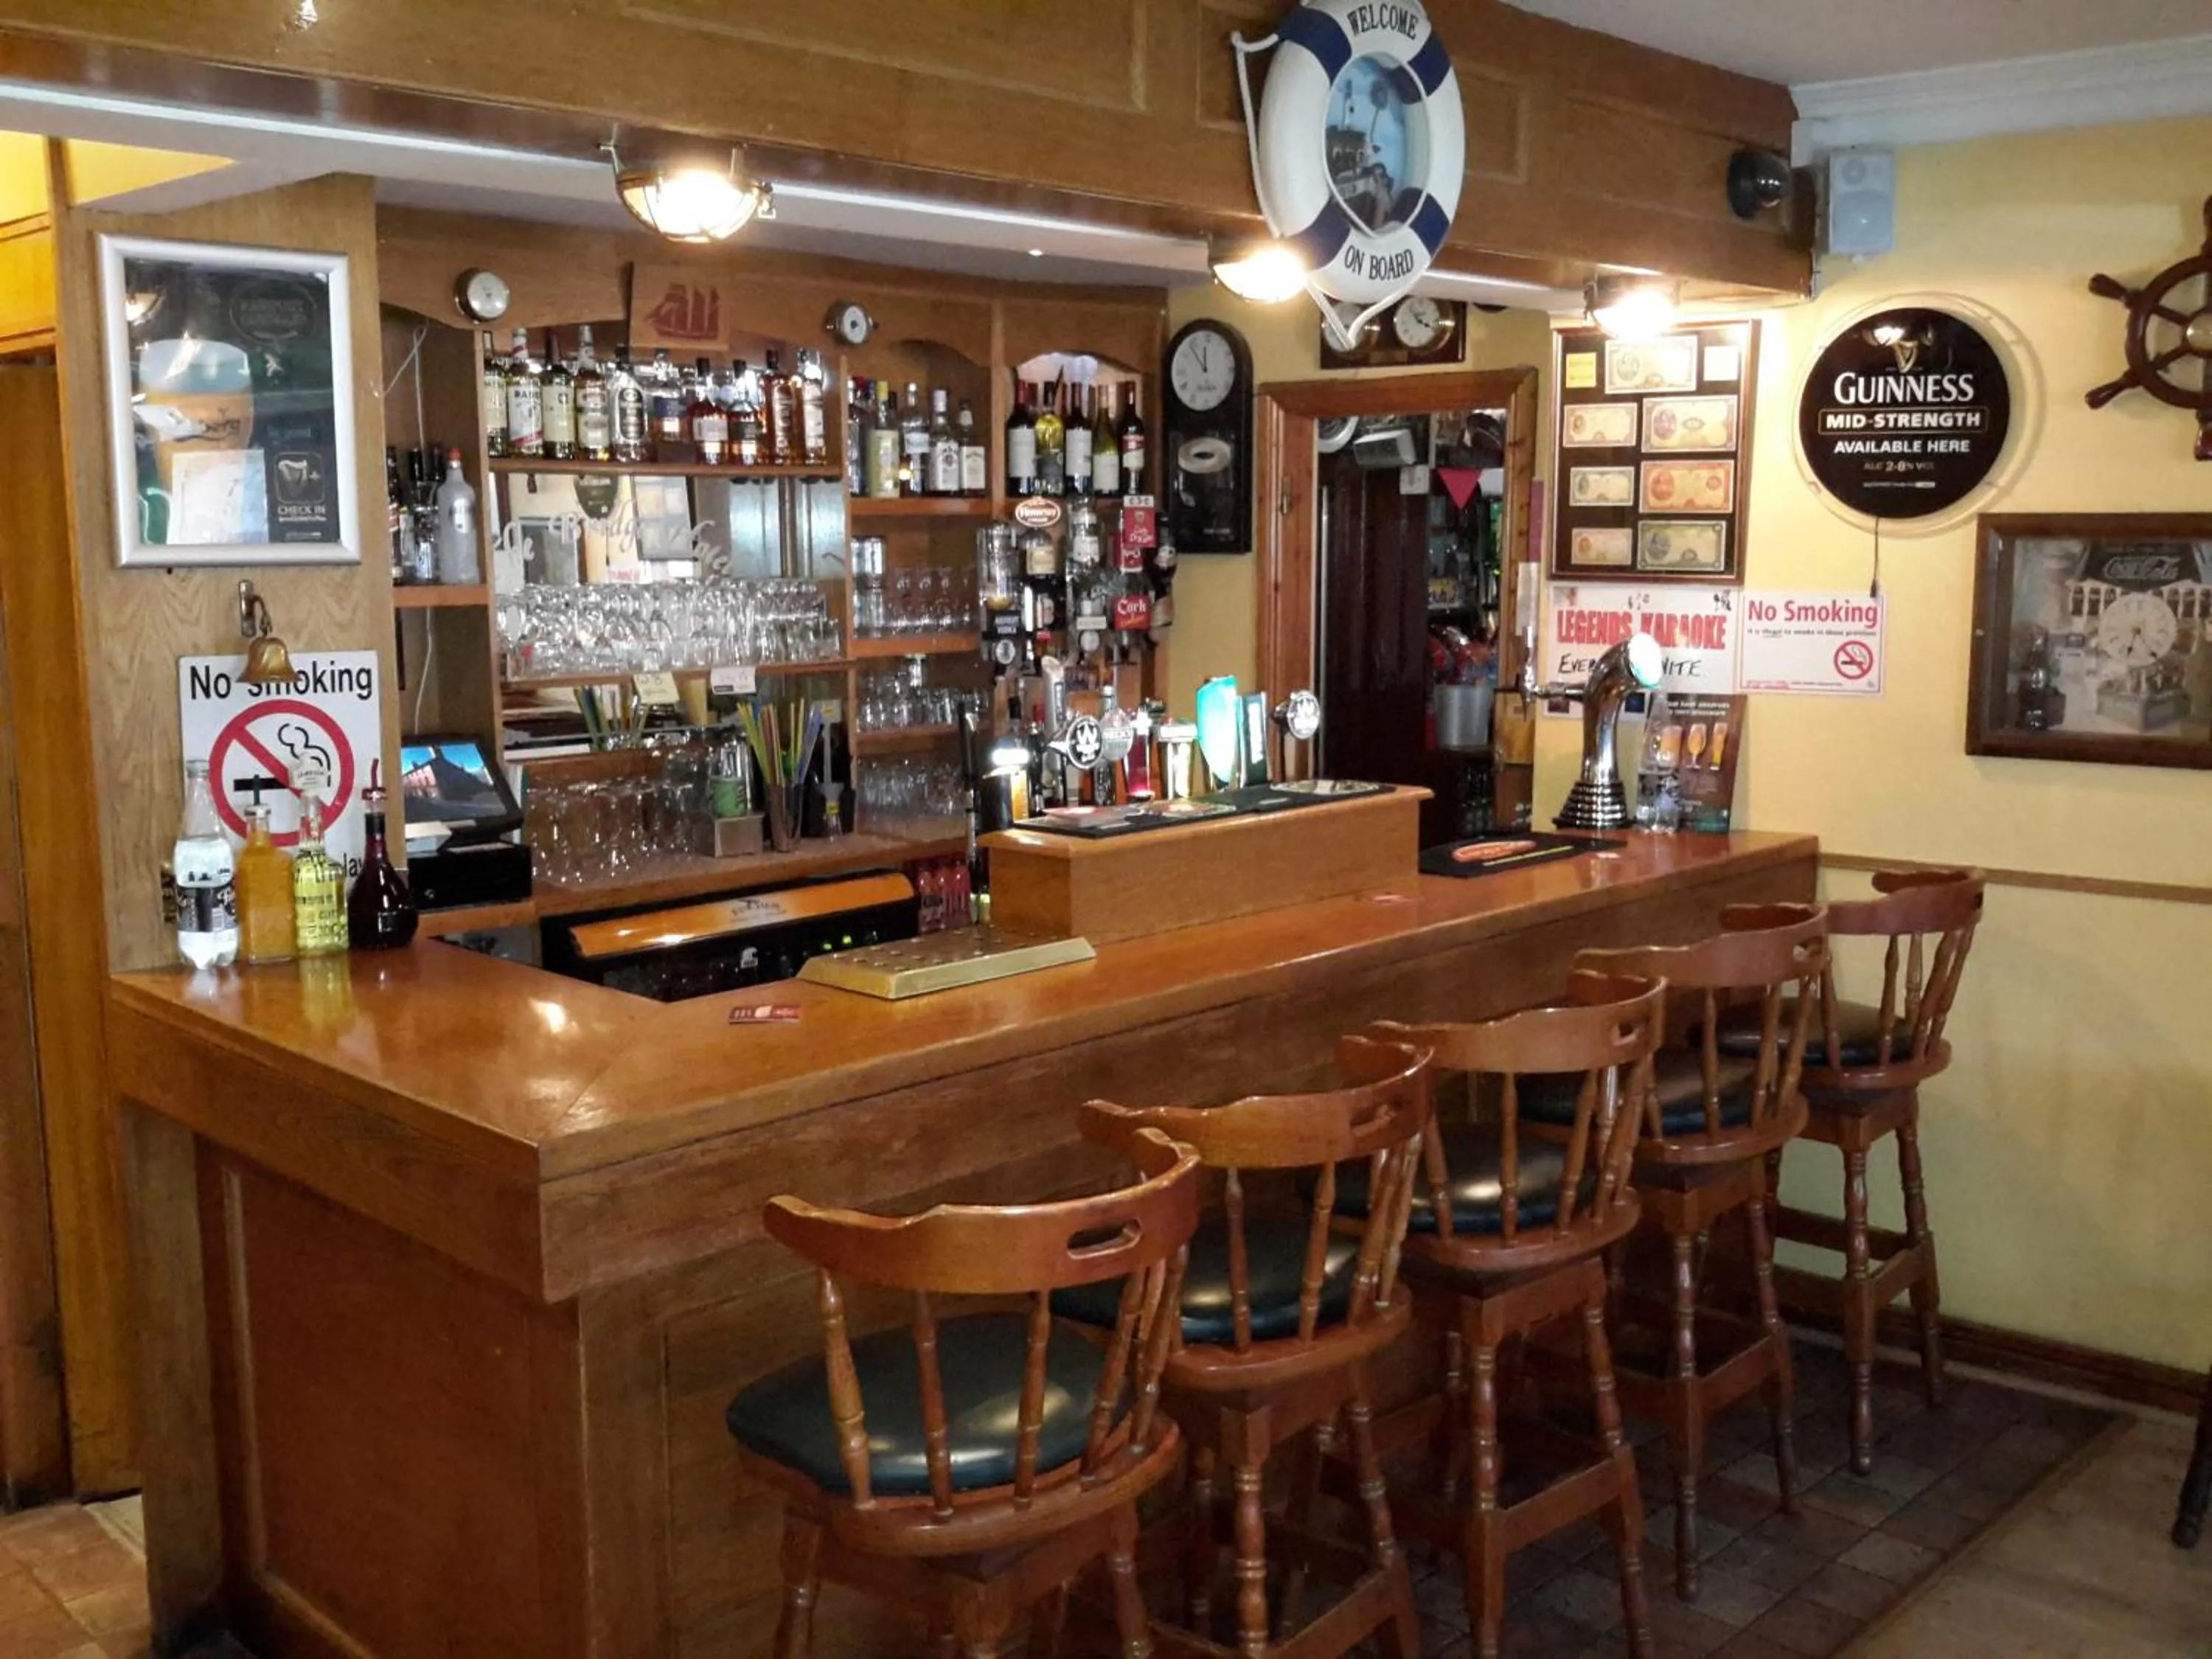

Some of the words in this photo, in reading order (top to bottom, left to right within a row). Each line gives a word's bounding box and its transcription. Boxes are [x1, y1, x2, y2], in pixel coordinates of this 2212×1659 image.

[1347, 2, 1419, 40] WELCOME
[1344, 244, 1364, 277] ON
[1369, 248, 1413, 281] BOARD
[1834, 371, 1975, 405] GUINNESS
[1826, 411, 1980, 429] MID-STRENGTH
[1834, 439, 1922, 454] AVAILABLE
[1927, 439, 1970, 453] HERE
[1557, 609, 1633, 644] LEGENDS
[1747, 599, 1778, 622] No
[1784, 599, 1879, 630] Smoking
[189, 664, 232, 700] No
